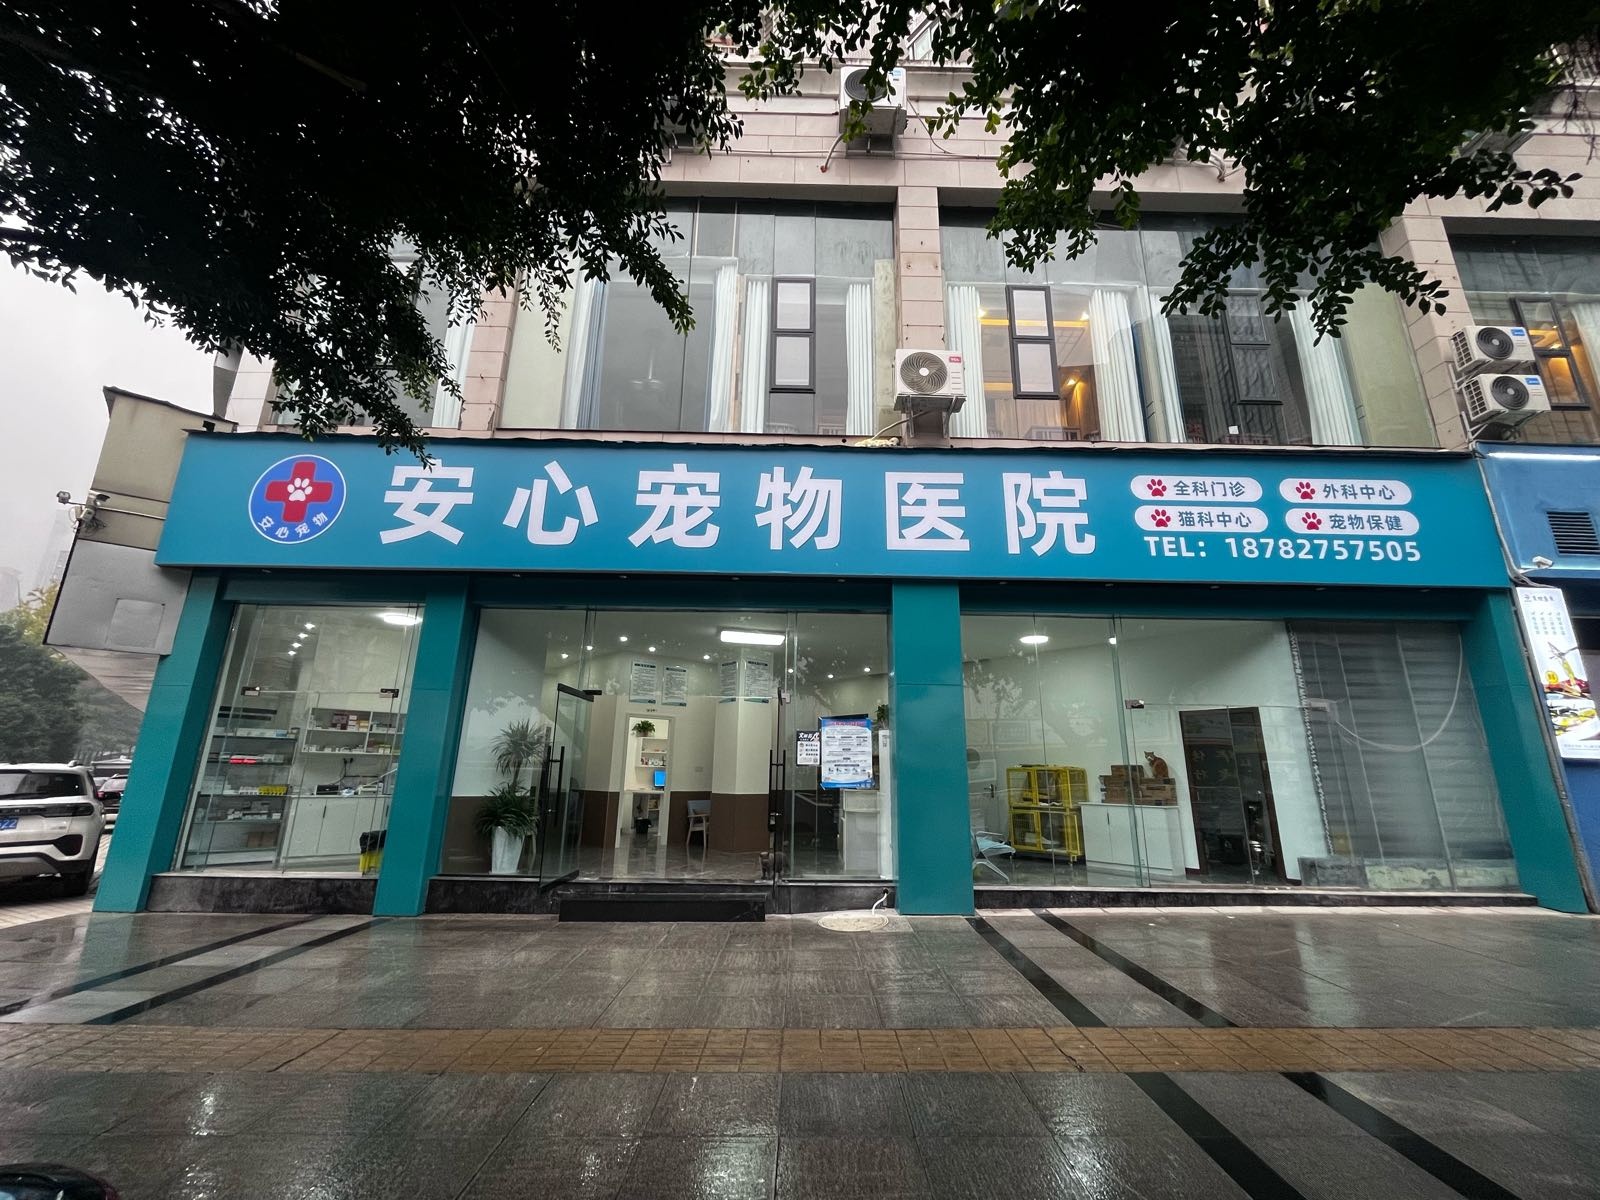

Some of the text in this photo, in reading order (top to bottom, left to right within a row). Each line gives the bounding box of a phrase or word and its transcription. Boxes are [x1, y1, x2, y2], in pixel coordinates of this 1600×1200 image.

[1173, 480, 1246, 498] 全科门诊
[1322, 483, 1396, 500] 外科中心
[379, 458, 1096, 557] 安心宠物医院
[257, 512, 329, 539] 安心宠物
[1178, 511, 1252, 528] 猫科中心
[1329, 514, 1404, 531] 宠物保健
[1144, 536, 1421, 561] TEL： 18782757505
